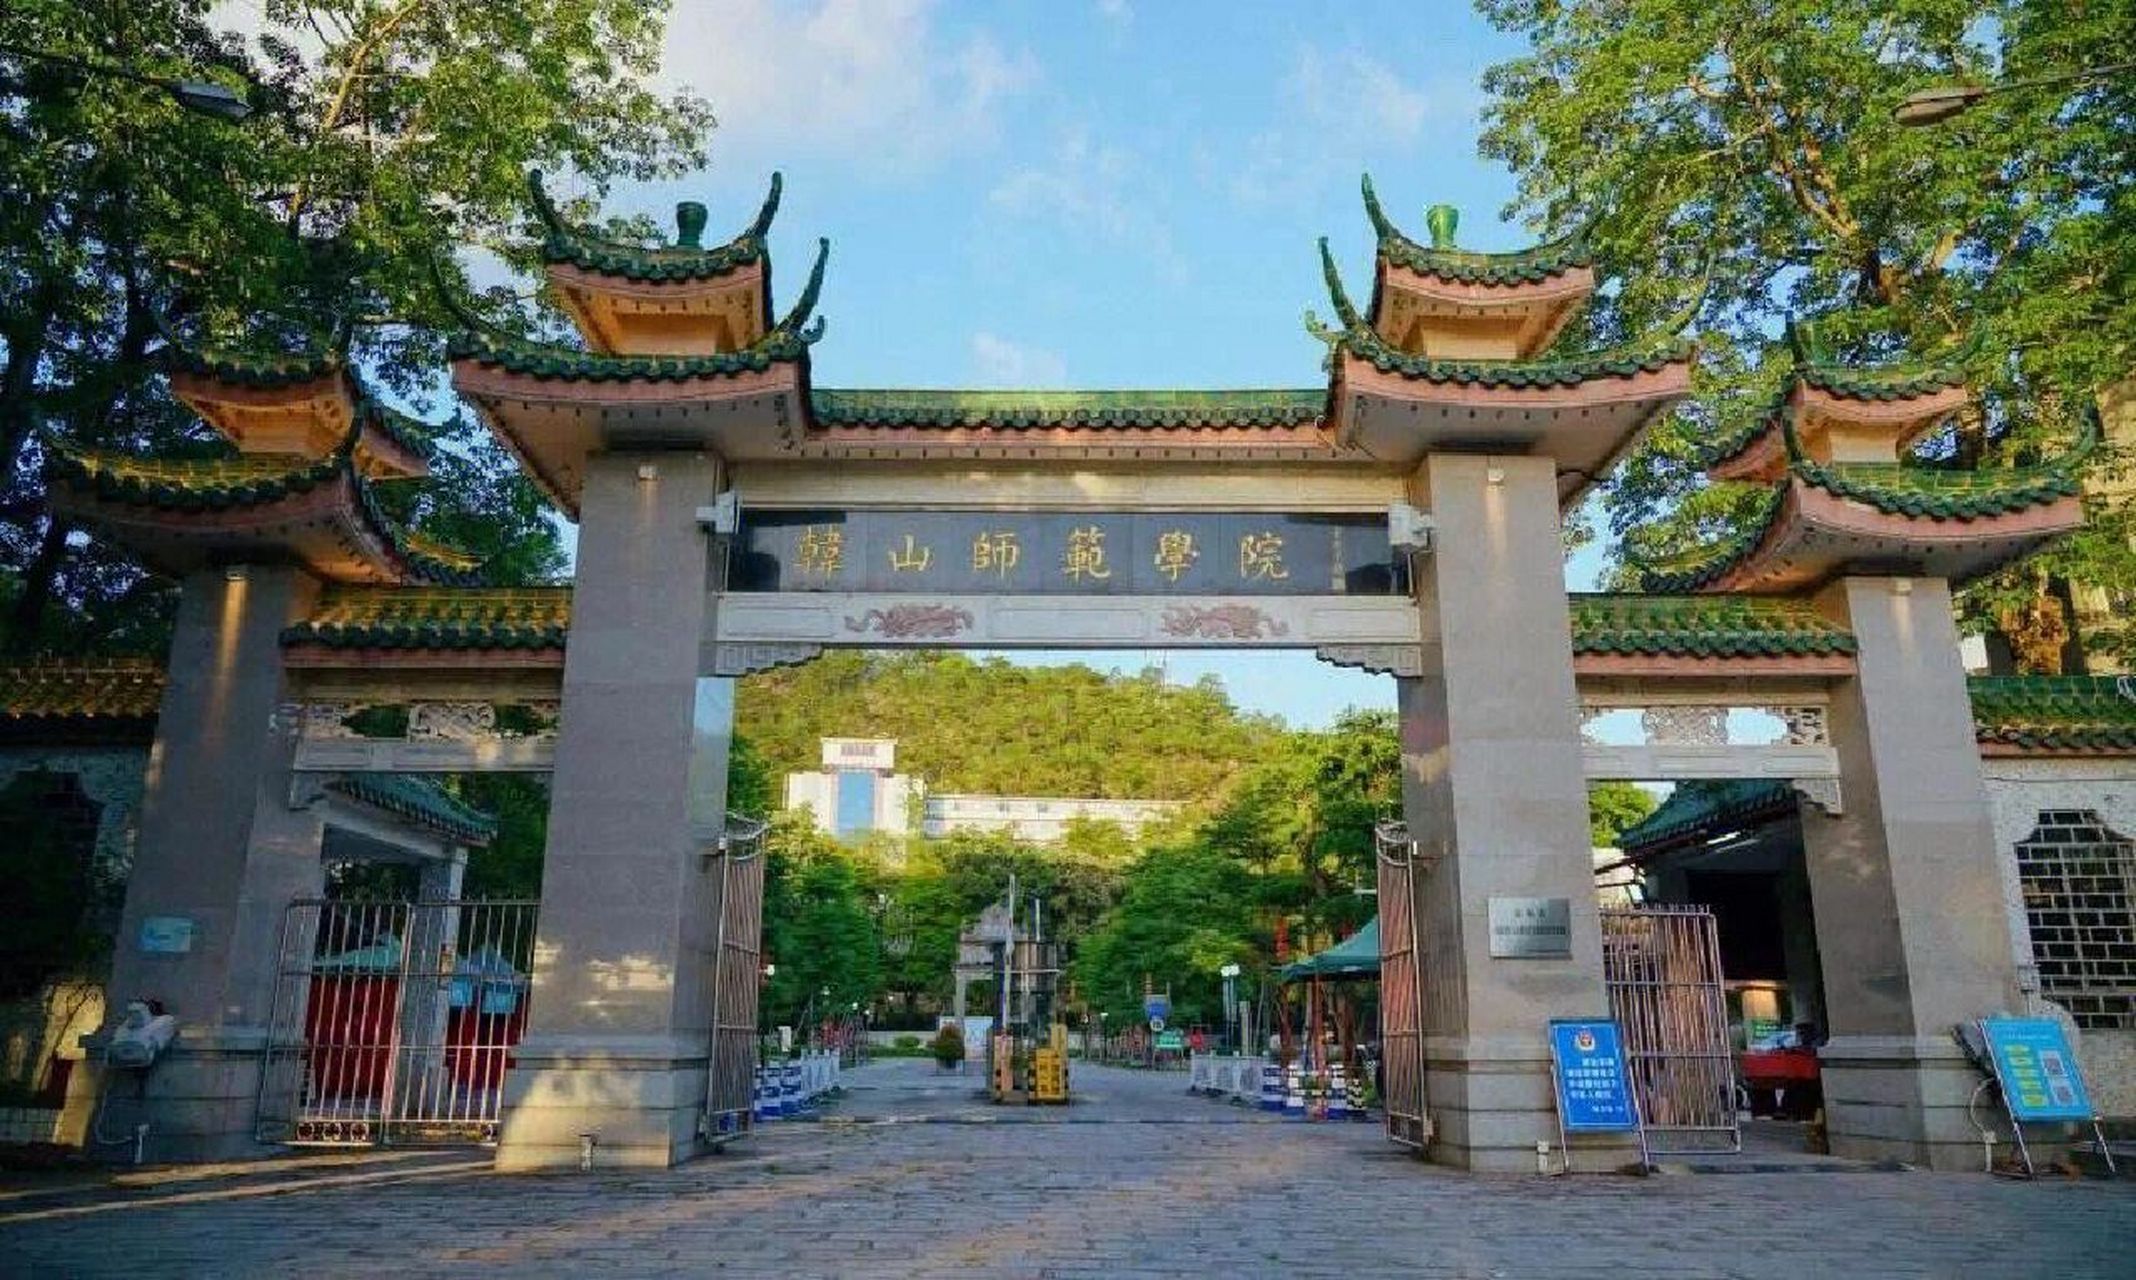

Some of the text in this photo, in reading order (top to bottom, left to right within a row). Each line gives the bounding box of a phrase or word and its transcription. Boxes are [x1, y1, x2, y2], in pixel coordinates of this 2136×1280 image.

[794, 525, 1290, 582] 韓山師範學院
